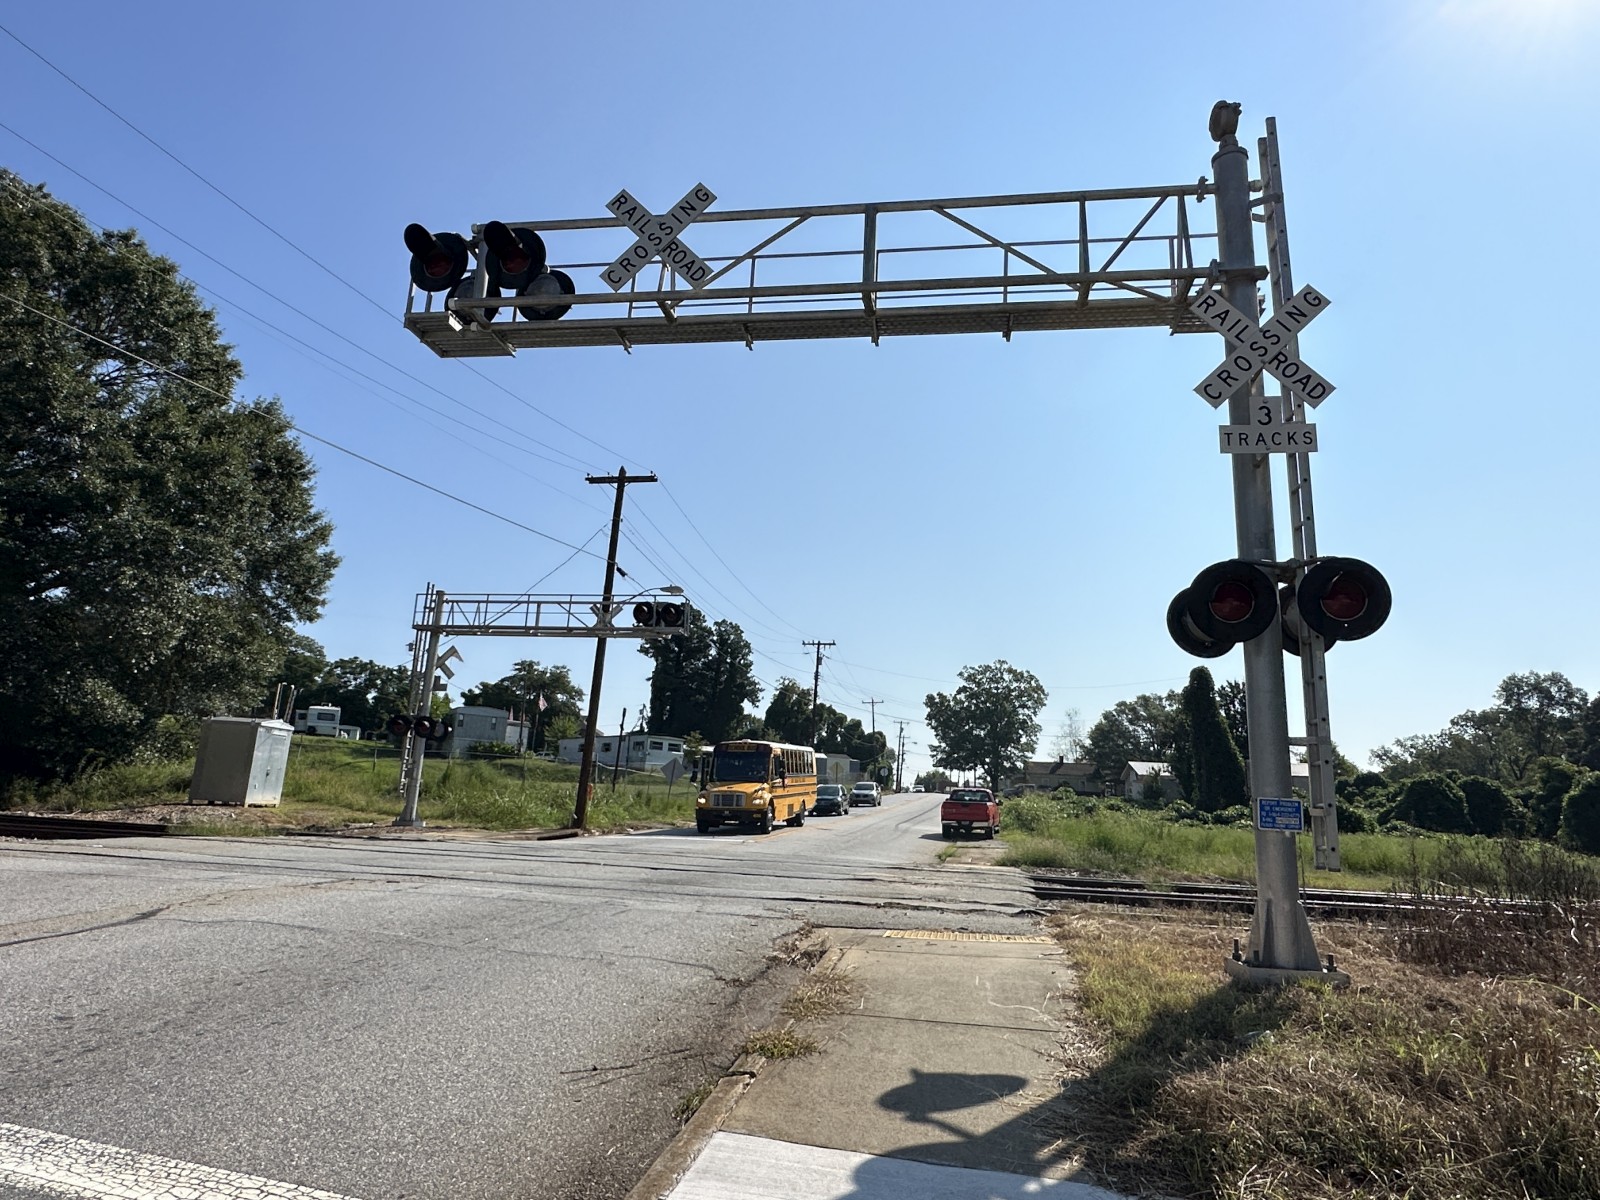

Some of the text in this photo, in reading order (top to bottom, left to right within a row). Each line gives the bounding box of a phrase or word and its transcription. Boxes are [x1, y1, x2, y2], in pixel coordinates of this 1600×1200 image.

[607, 188, 709, 285] CROSSING
[1203, 291, 1322, 400] CROSSING
[1224, 431, 1313, 446] TRACKS
[1257, 405, 1272, 426] 3
